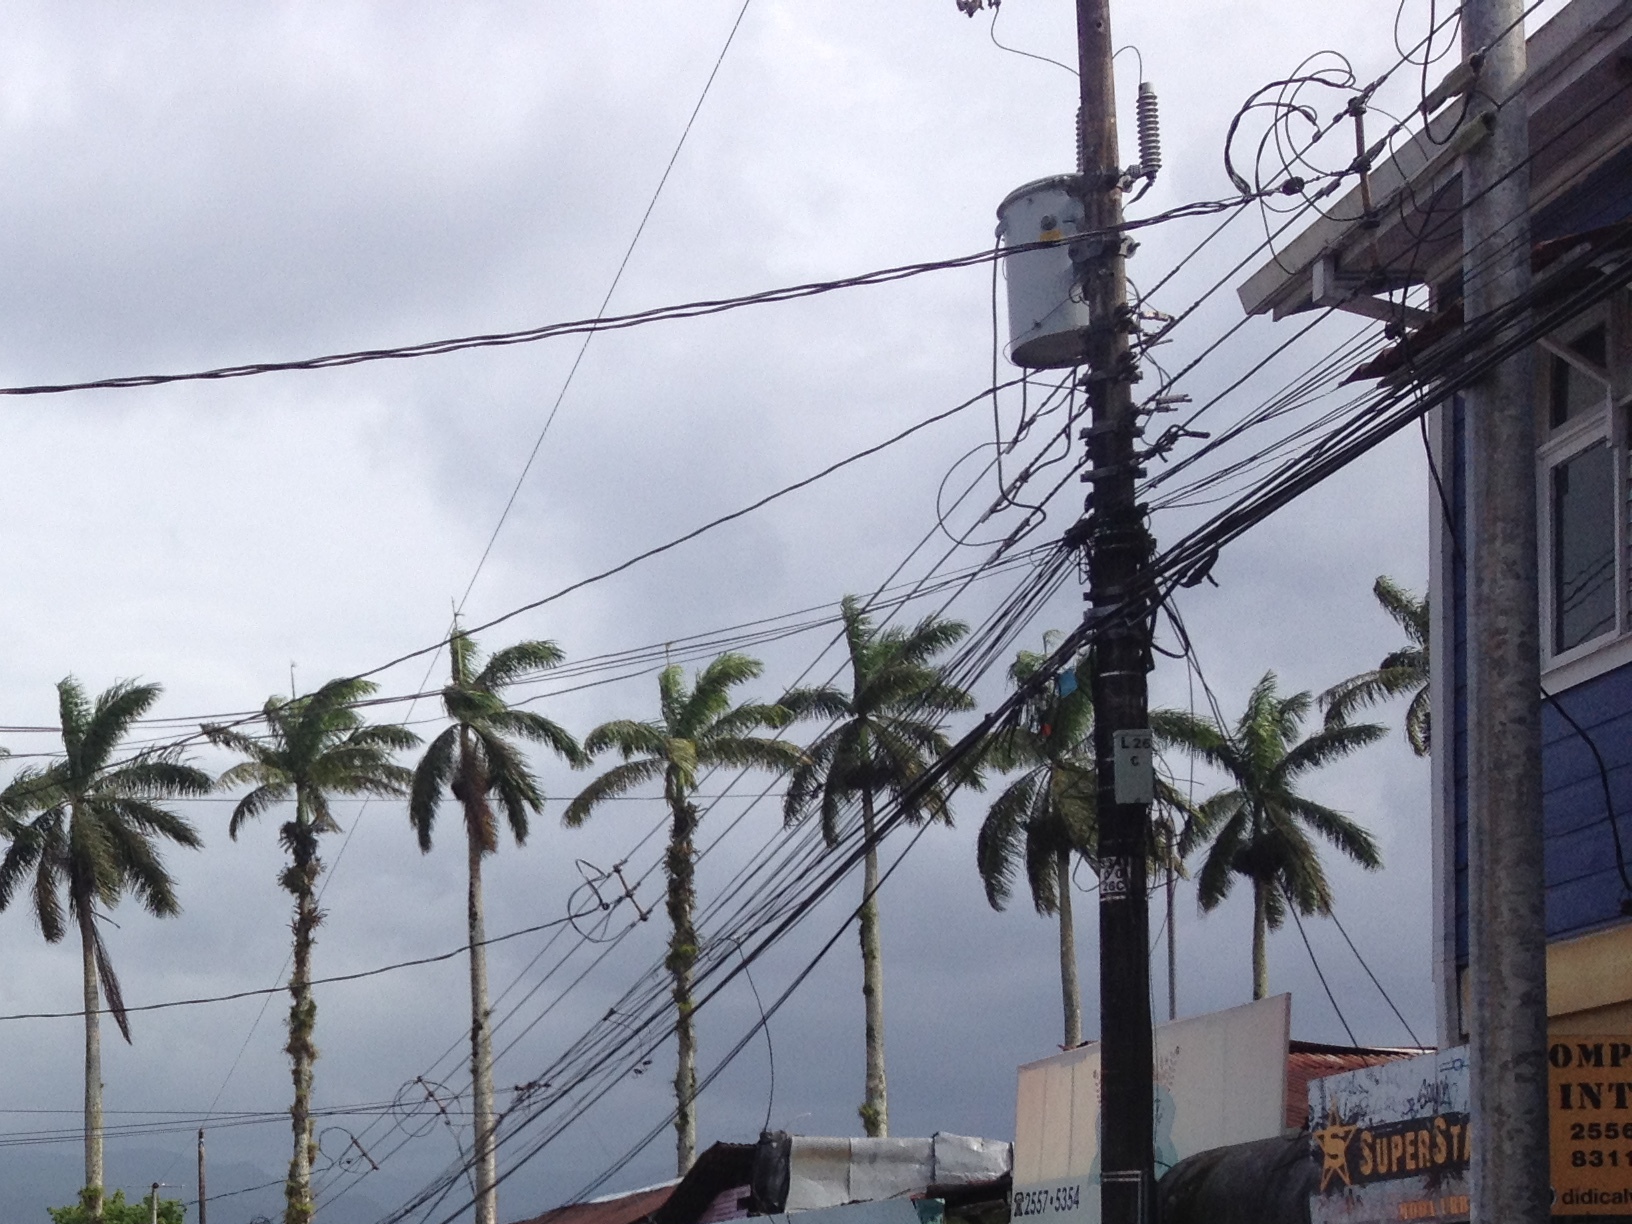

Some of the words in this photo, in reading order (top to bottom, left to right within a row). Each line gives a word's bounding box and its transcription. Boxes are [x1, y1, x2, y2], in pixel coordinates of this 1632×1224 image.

[1133, 737, 1151, 749] 26
[1549, 1043, 1632, 1068] OMP
[1559, 1082, 1632, 1110] INT
[1570, 1123, 1632, 1140] 2556
